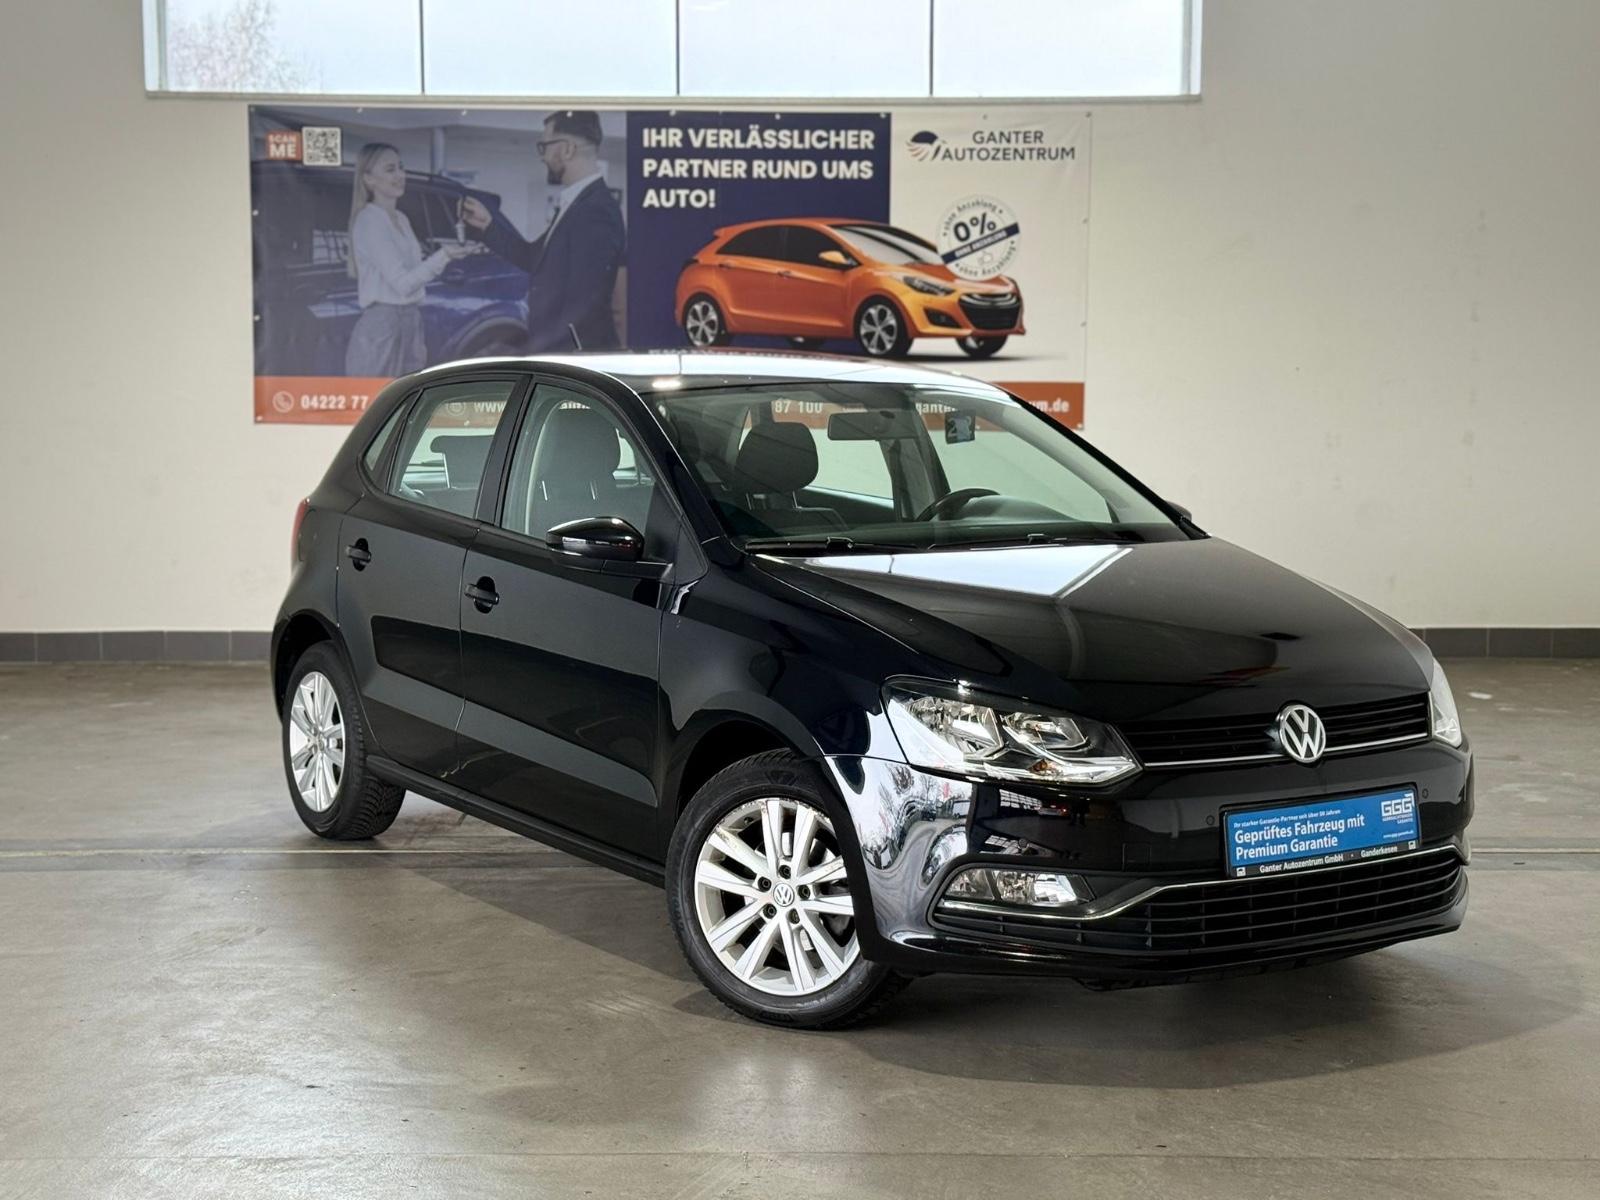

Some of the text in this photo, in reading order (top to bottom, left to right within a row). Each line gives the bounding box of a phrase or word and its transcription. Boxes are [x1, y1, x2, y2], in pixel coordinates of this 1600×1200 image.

[643, 124, 875, 149] IHR VERLÄSSLICHER
[972, 130, 1044, 144] GANTER
[270, 143, 297, 158] ME
[941, 147, 1076, 161] AUTOZENTRUM
[643, 158, 874, 179] PARTNER RUND UMS
[642, 188, 716, 209] AUTO!
[953, 212, 997, 242] 0%
[300, 394, 369, 409] 04222 77
[774, 399, 823, 413] 87 100
[1381, 794, 1415, 816] GGG
[1235, 825, 1292, 845] Geprüftes
[1294, 820, 1345, 836] Fahrzeug
[1347, 814, 1365, 828] mit
[1236, 834, 1338, 860] Premium Garantie
[1260, 863, 1282, 873] Ganter
[1283, 857, 1323, 870] Autozentrum
[1324, 853, 1344, 864] GmbH
